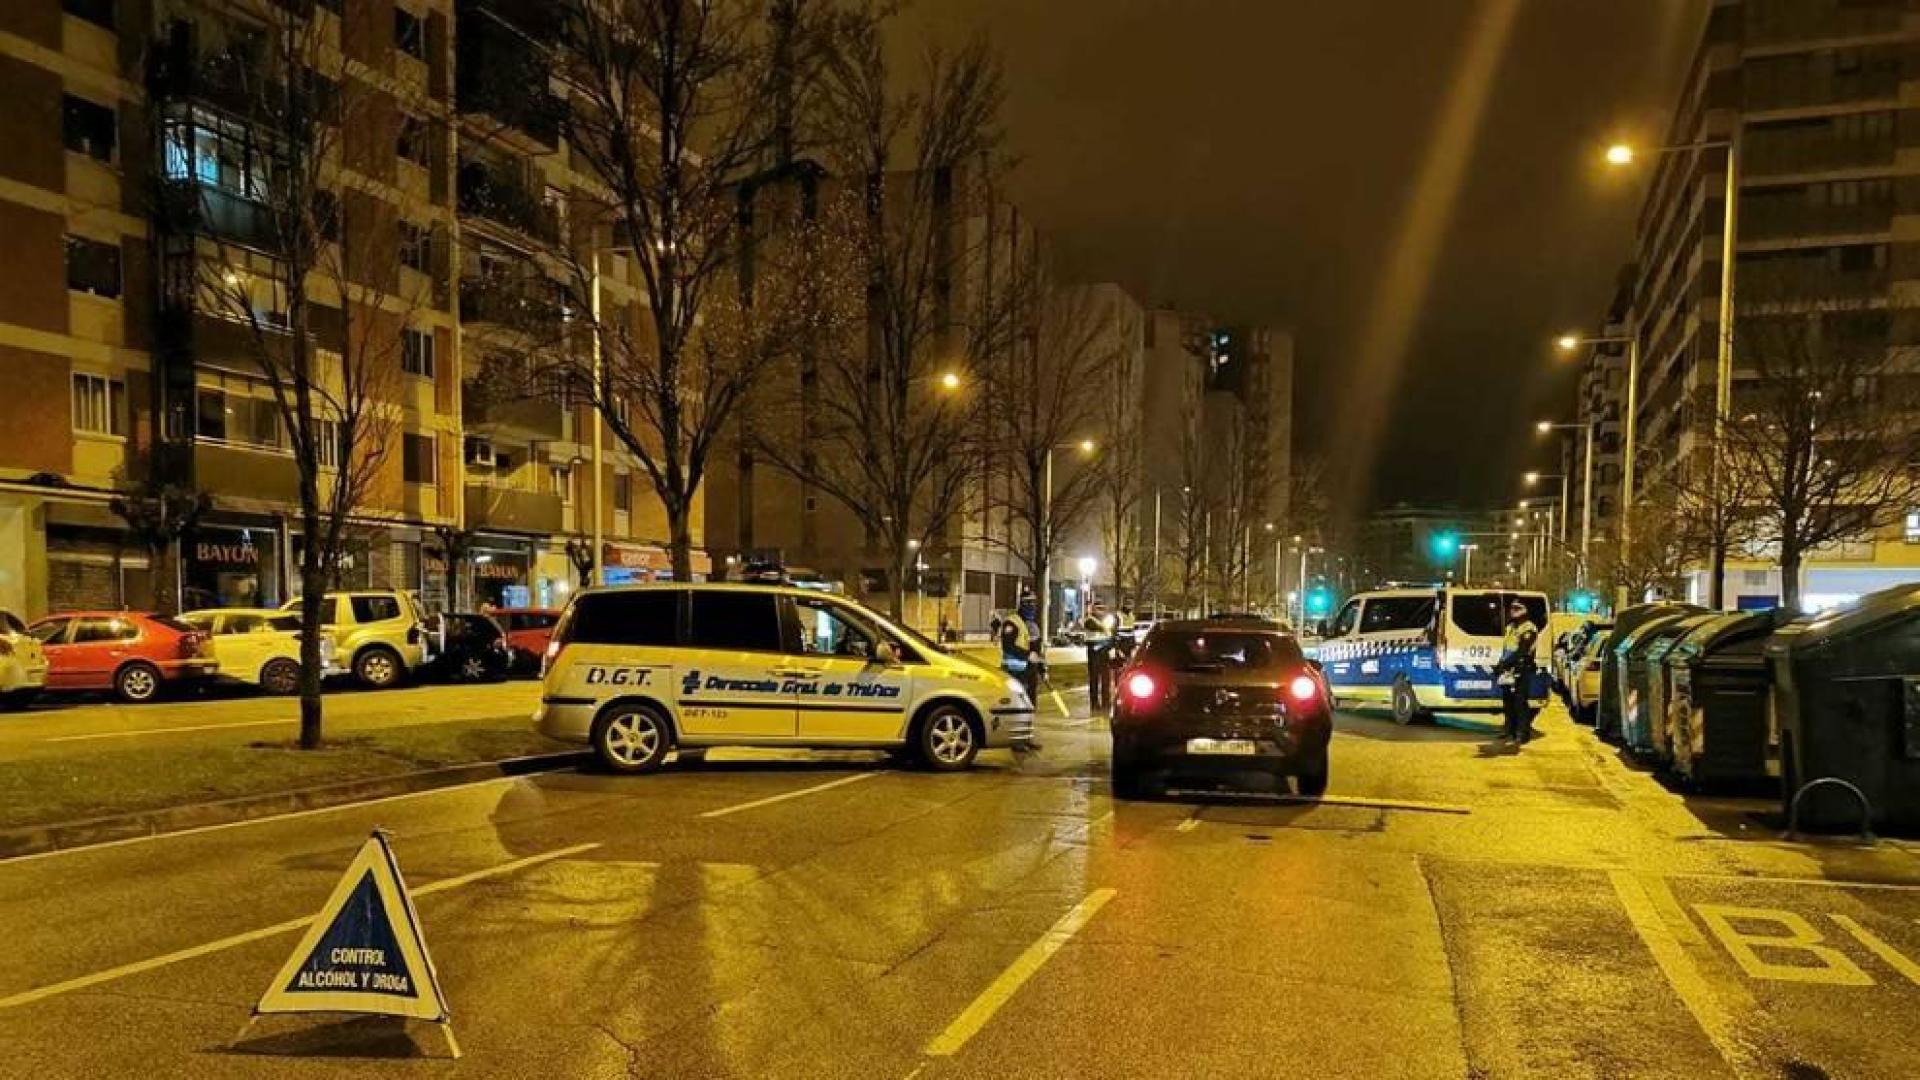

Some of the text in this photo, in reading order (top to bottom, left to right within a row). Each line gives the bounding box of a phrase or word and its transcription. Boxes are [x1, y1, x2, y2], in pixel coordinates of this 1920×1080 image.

[1469, 645, 1492, 658] 092
[586, 668, 652, 686] D.G.T.
[330, 948, 386, 966] CONTROL
[298, 971, 408, 992] ALCOHOL Y DROGA
